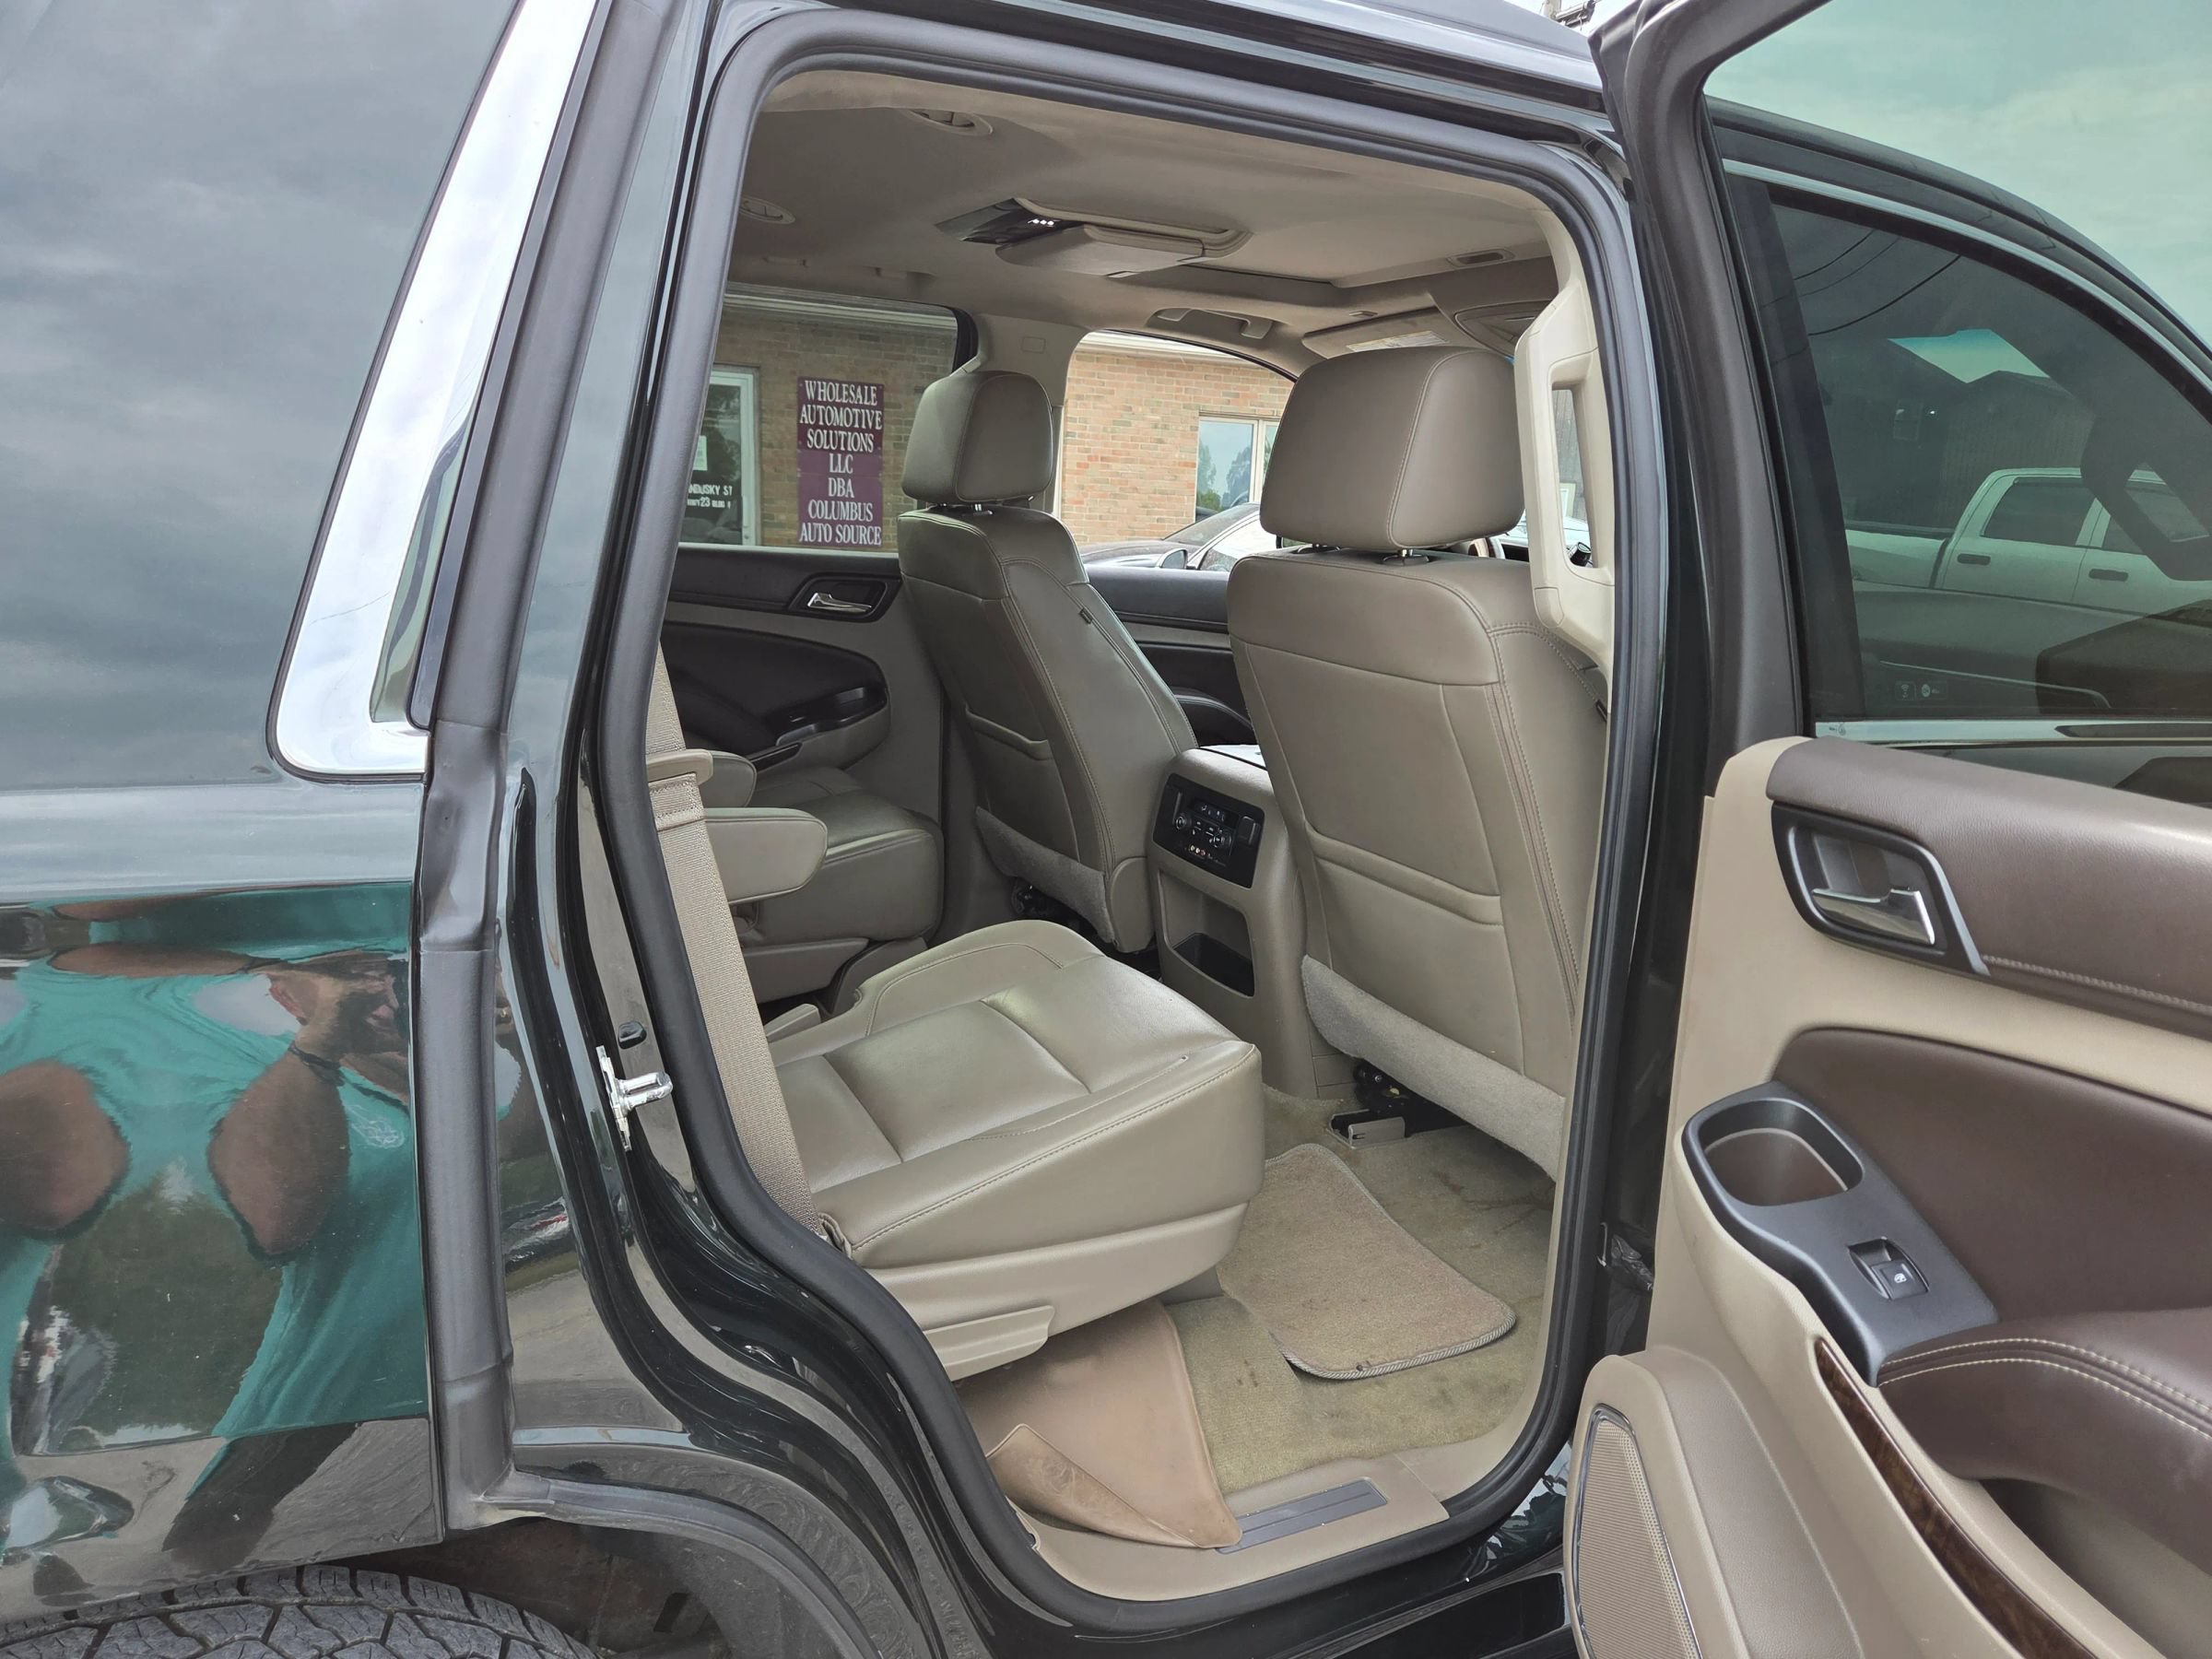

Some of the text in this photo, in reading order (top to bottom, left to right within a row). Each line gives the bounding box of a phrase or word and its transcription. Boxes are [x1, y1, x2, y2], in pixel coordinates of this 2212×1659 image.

[805, 380, 877, 406] WHOLESALE
[800, 404, 883, 430] AUTOMOTIVE
[806, 429, 875, 453] SOLUTIONS
[830, 453, 853, 474] LLC
[723, 485, 733, 496] ST
[828, 477, 855, 498] DBA
[808, 499, 874, 522] COLUMBUS
[799, 522, 882, 546] AUTO SOURCE
